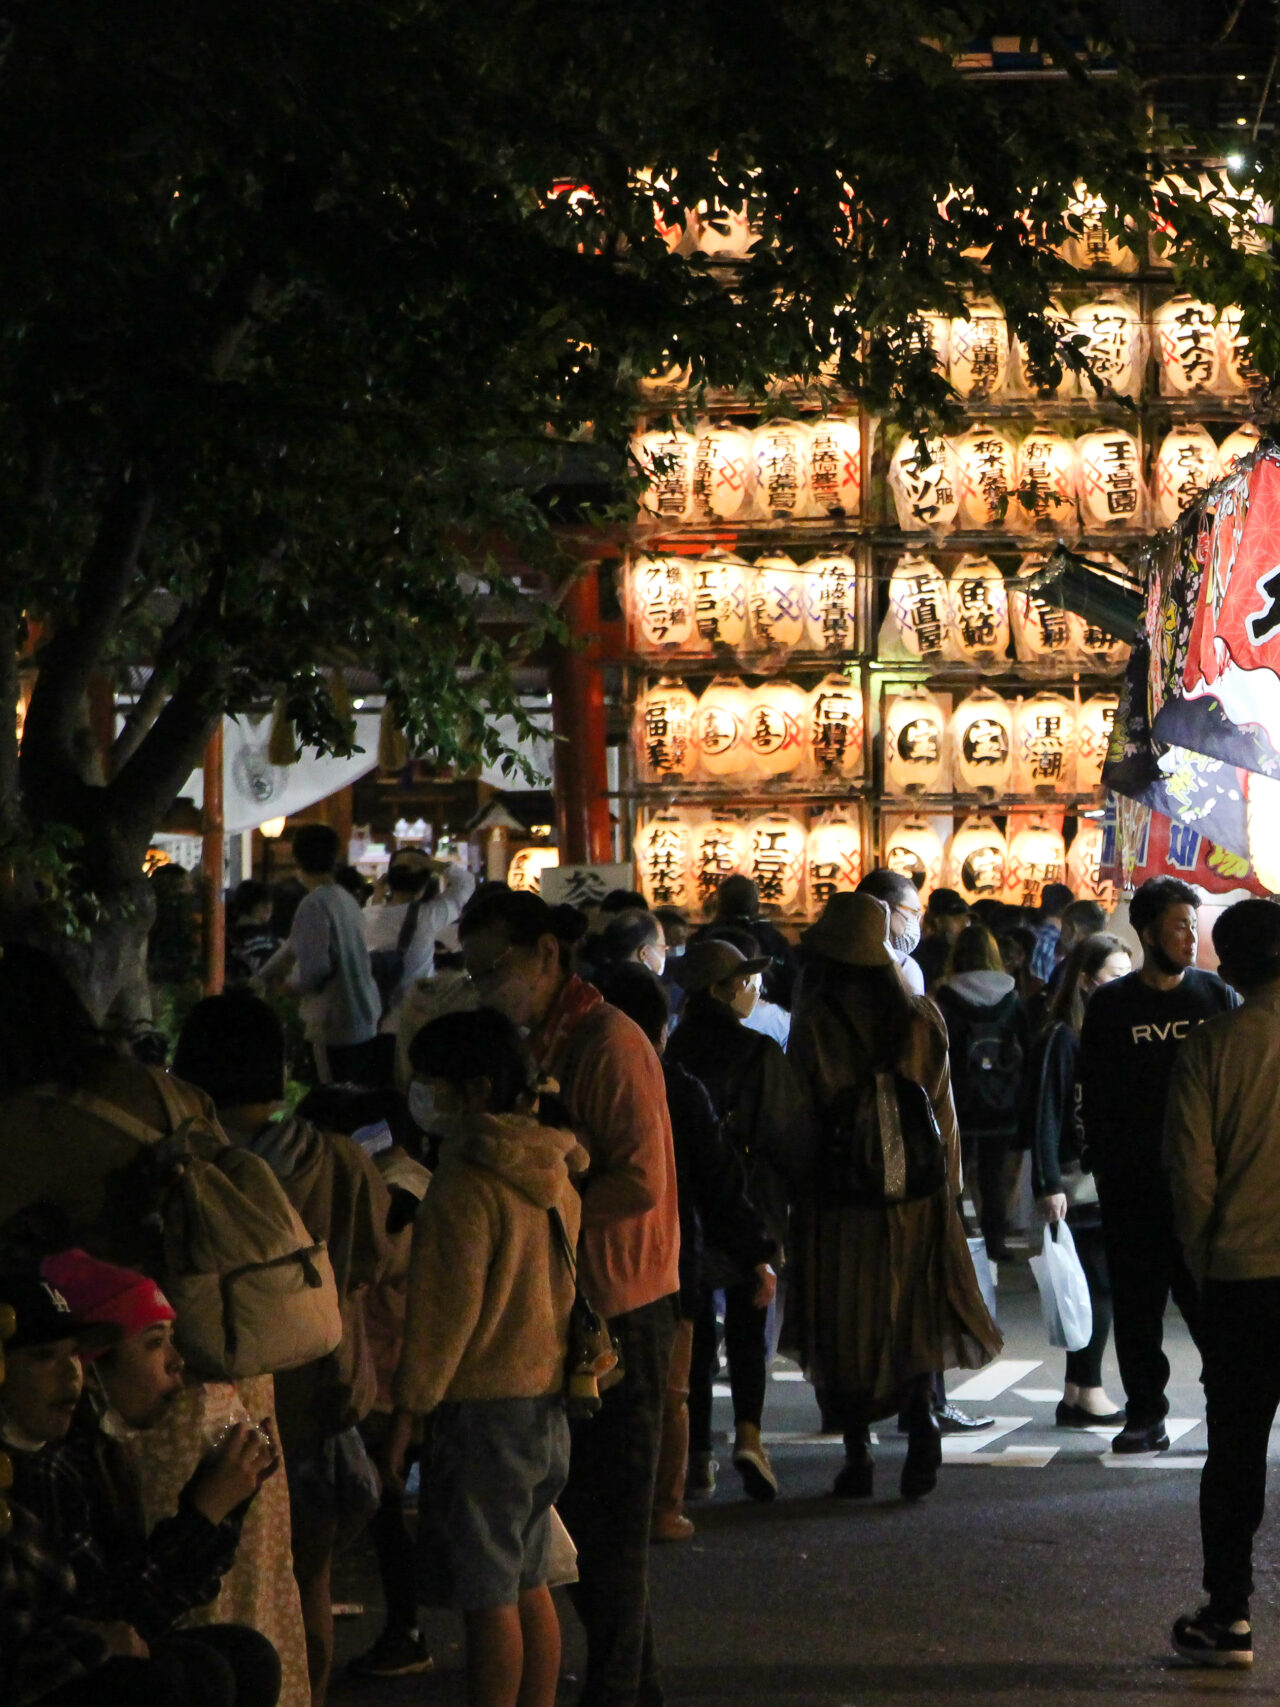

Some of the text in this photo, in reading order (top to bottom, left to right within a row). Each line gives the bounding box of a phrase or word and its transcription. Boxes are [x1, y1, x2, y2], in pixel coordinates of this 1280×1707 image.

[1112, 315, 1127, 375] フルーツ
[1104, 440, 1137, 515] 王喜園
[645, 567, 670, 641] クリニック
[908, 574, 943, 652] 正直屋
[1032, 716, 1065, 780] 黒潮
[1131, 1018, 1205, 1045] RVC
